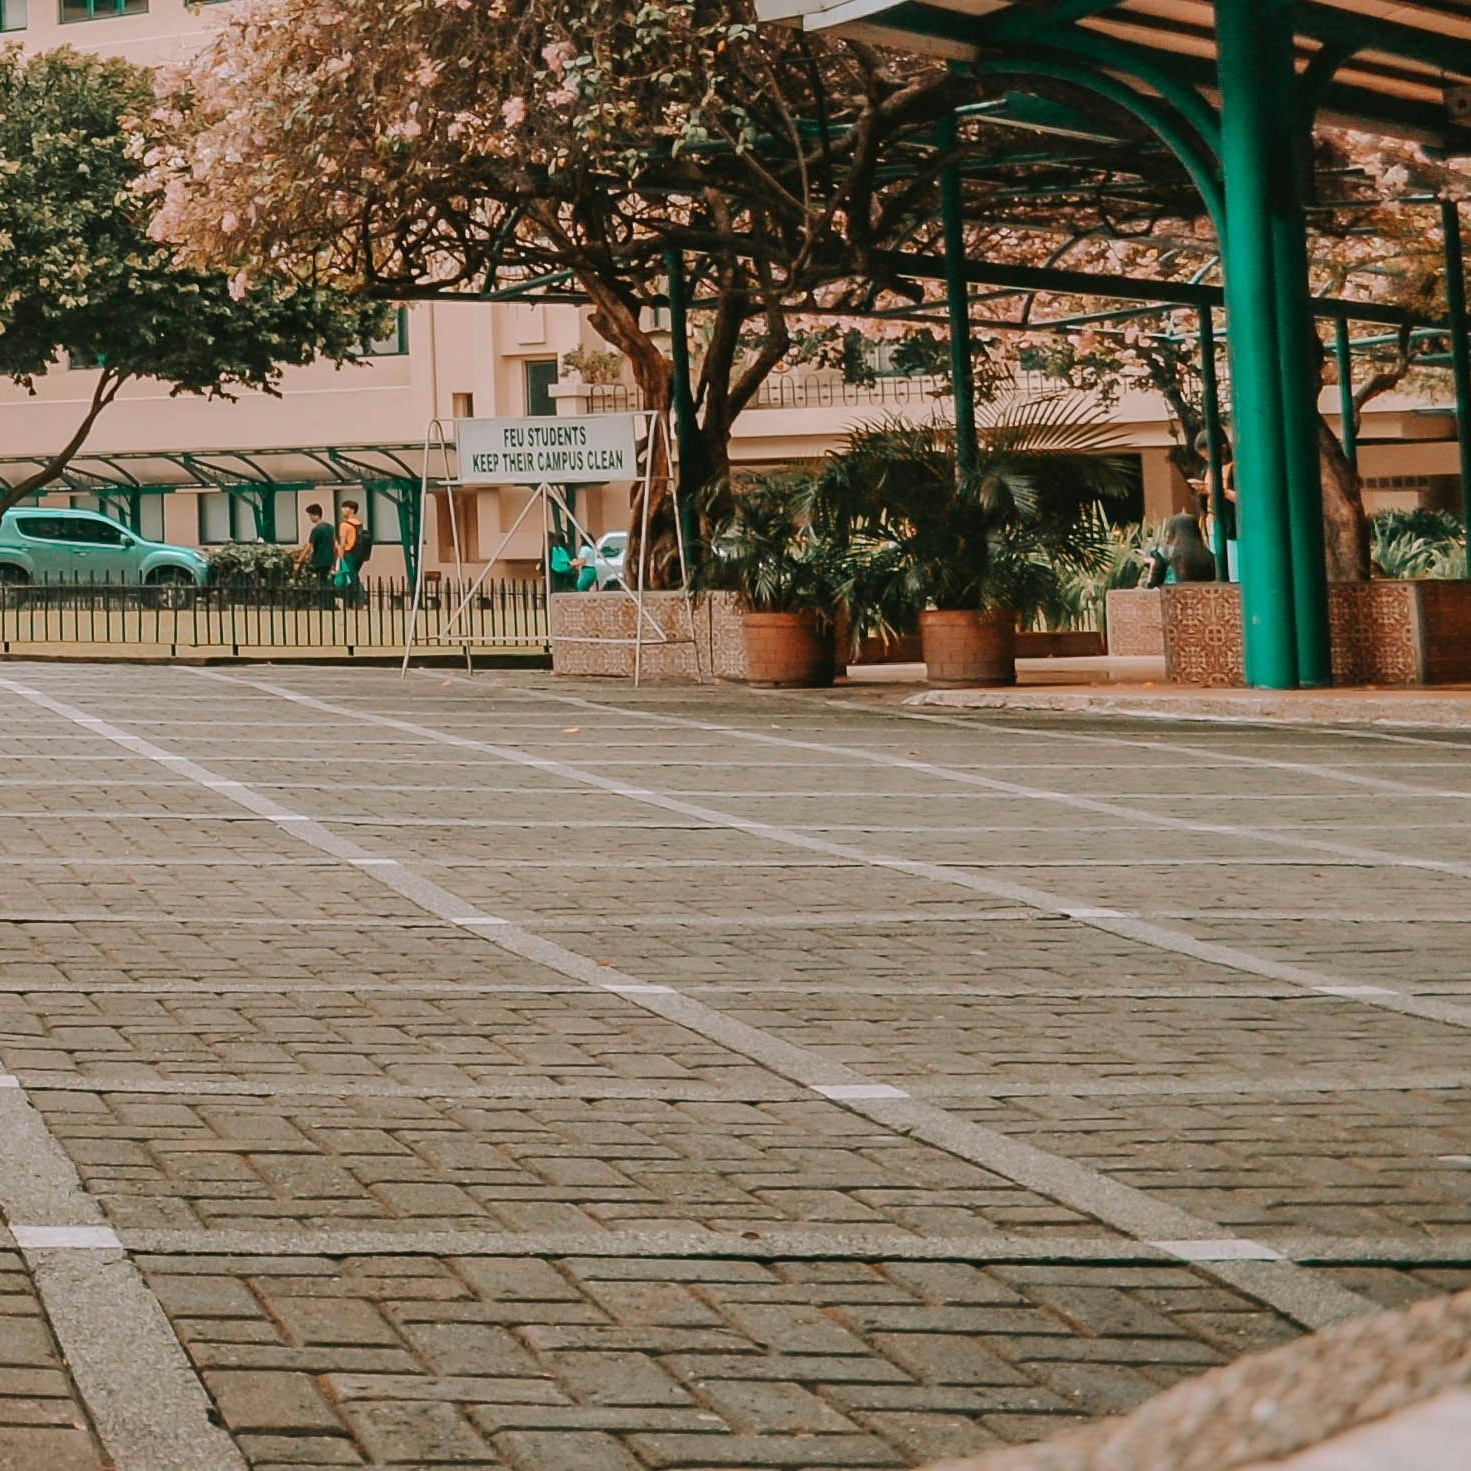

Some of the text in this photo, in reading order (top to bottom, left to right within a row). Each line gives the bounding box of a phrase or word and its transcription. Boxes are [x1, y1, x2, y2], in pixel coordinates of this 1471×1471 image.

[503, 426, 586, 447] FEU STUDENTS
[472, 449, 623, 473] KEEP THEIR CAMPUS CLEAN
